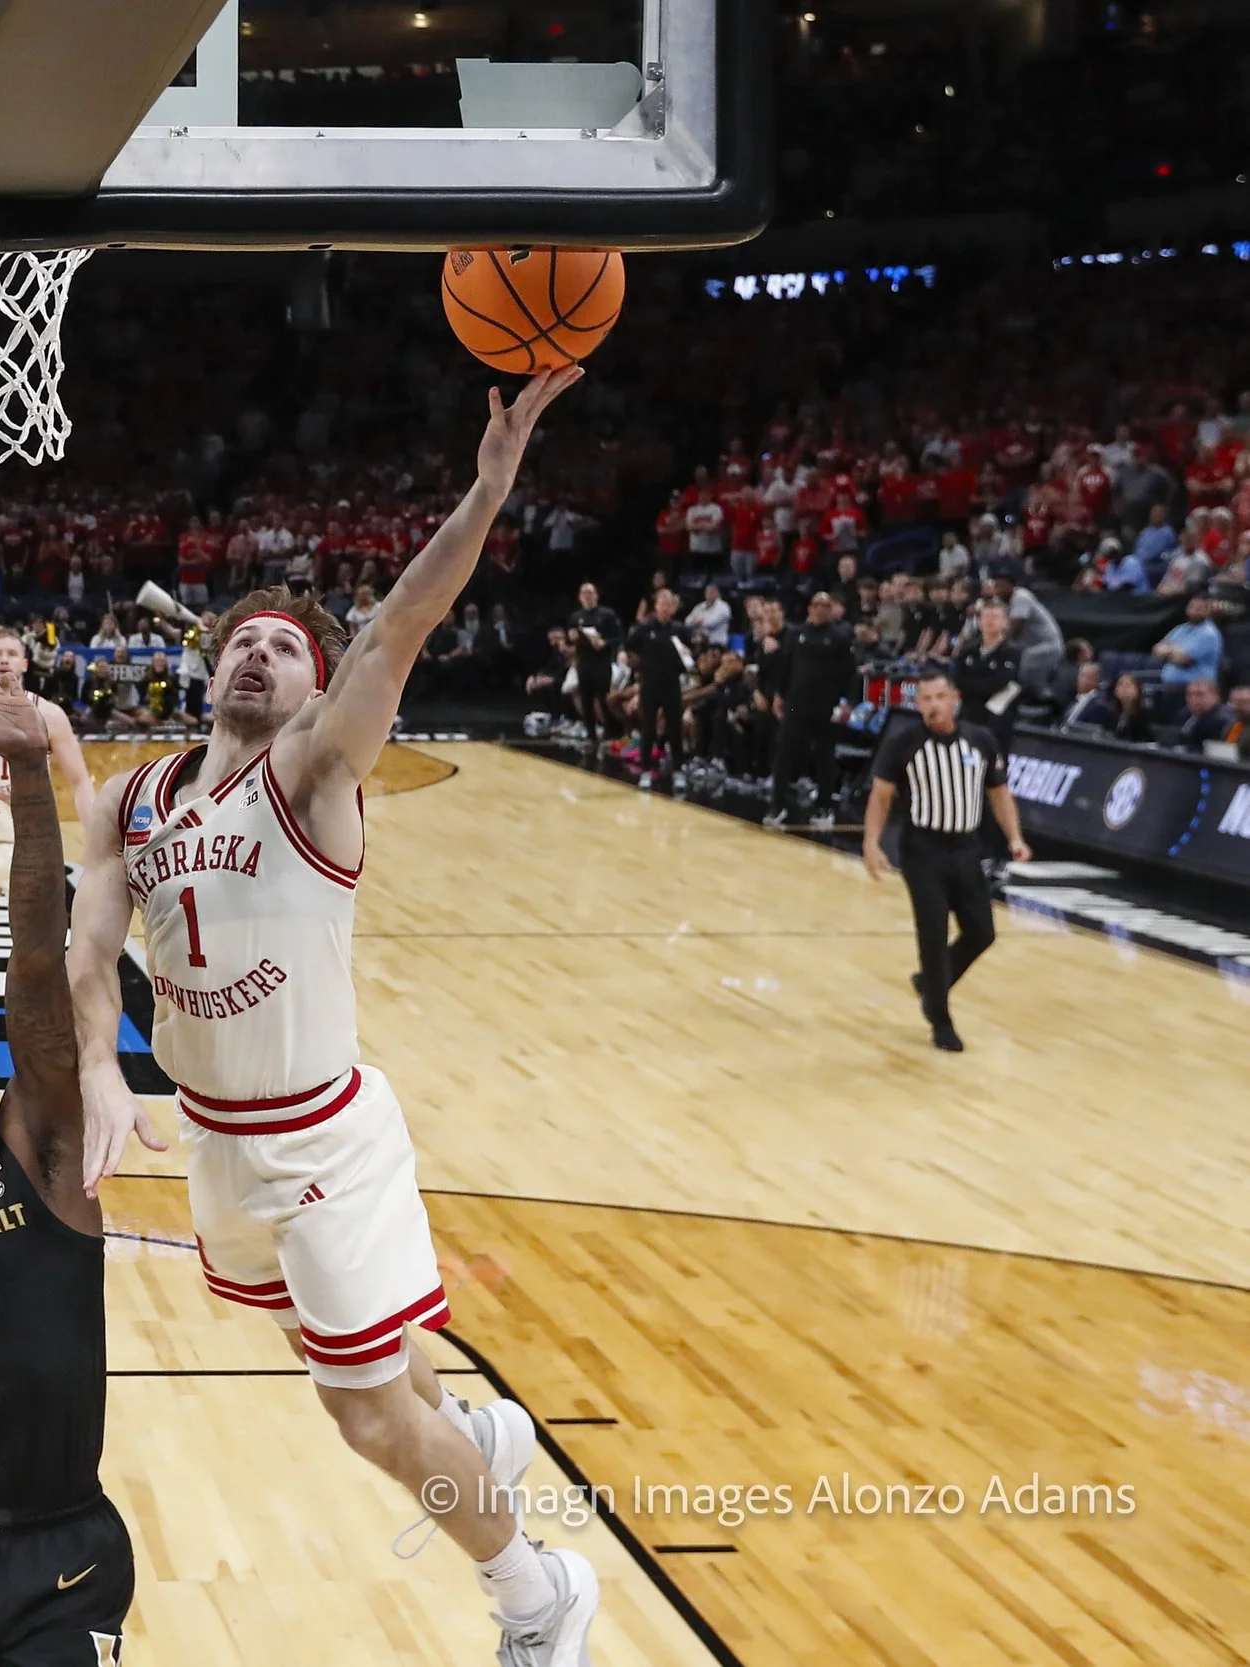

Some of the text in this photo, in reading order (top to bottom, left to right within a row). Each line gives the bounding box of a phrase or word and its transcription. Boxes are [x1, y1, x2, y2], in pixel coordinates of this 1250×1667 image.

[129, 834, 262, 904] NEBRASKA
[178, 886, 207, 968] 1
[154, 958, 288, 1020] ORNHUSKERS
